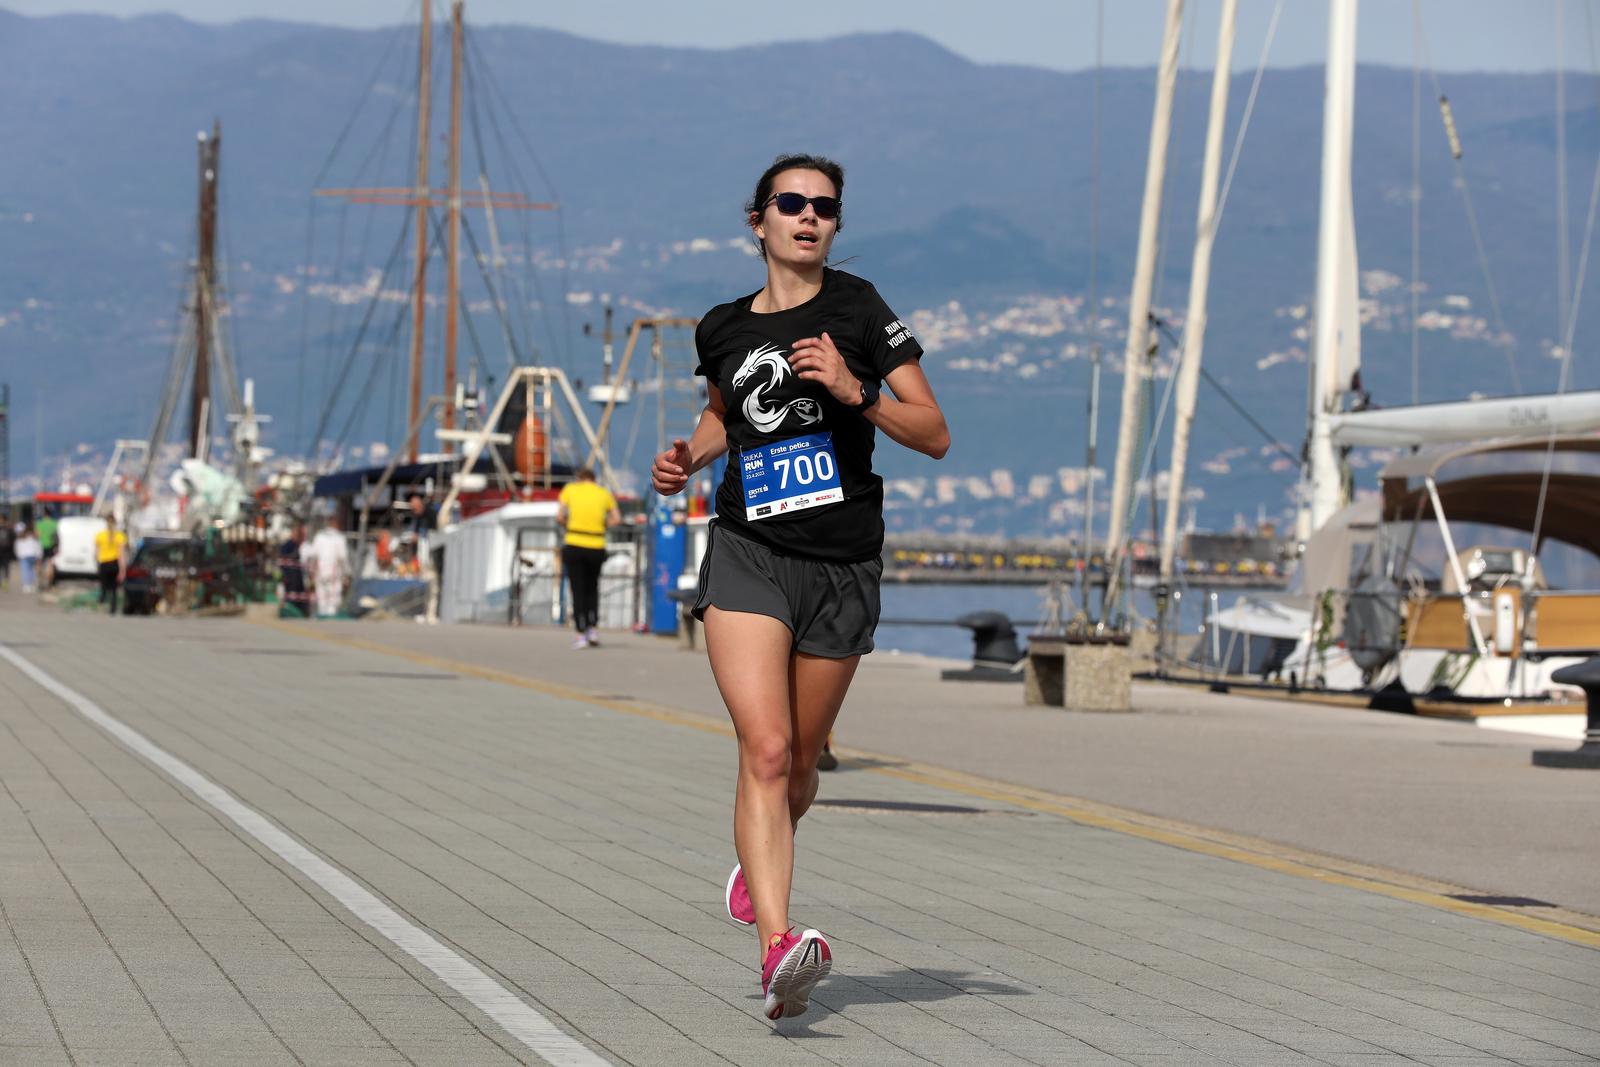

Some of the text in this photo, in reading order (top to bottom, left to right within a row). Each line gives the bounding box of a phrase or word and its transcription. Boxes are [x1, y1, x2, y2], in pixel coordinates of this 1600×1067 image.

[885, 321, 901, 335] RUN
[887, 332, 907, 348] YOUR
[770, 441, 809, 455] Erste petica
[744, 459, 764, 471] RUN
[773, 451, 834, 489] 700
[748, 487, 764, 496] ERSTE
[780, 501, 788, 511] A1
